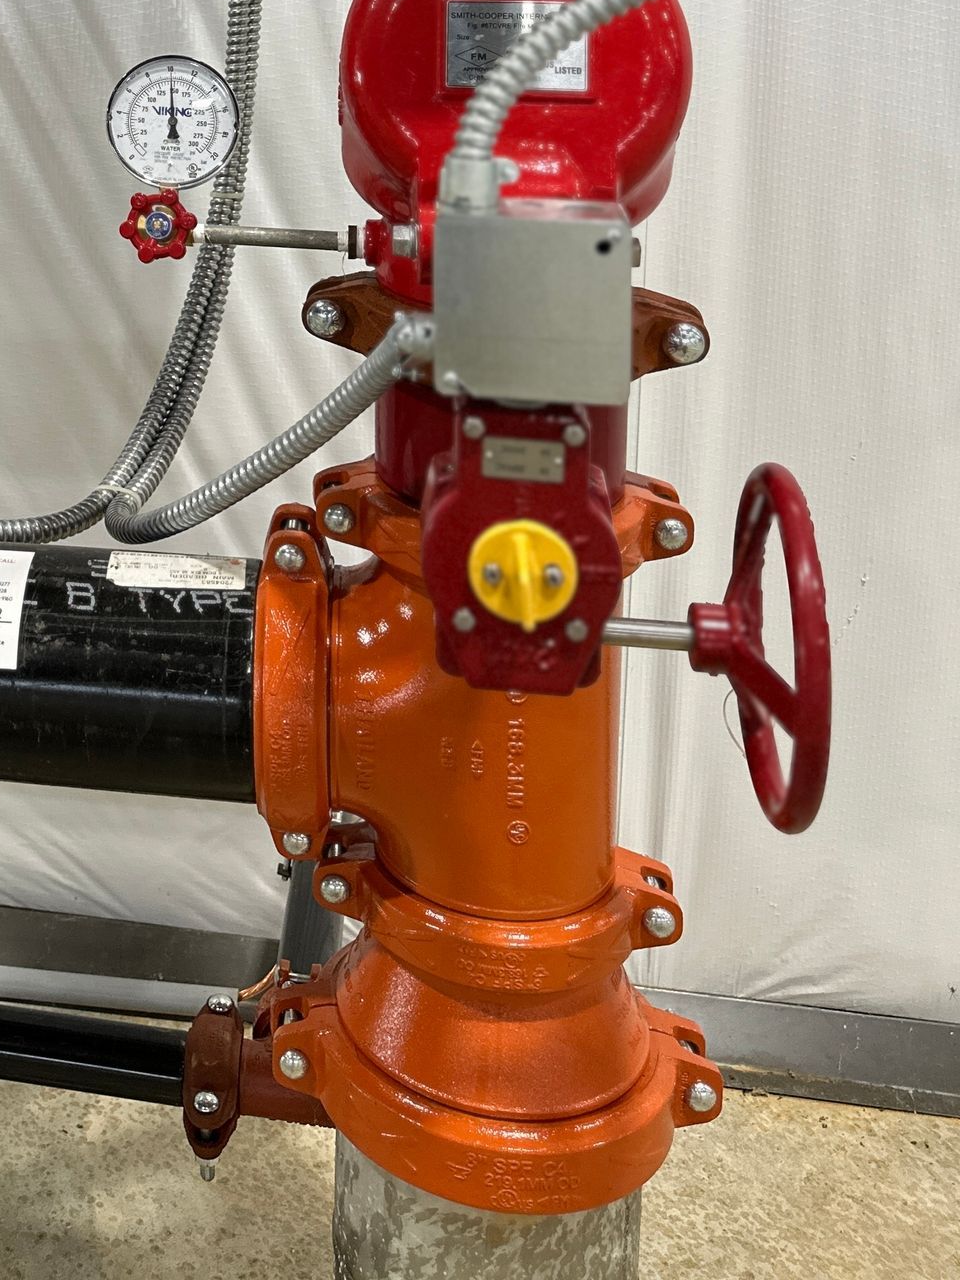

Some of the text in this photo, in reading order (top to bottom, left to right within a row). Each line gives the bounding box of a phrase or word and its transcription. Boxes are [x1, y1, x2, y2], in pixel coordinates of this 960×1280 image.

[471, 52, 487, 60] FM
[152, 106, 192, 117] VIKING
[210, 153, 219, 161] 20
[66, 582, 254, 614] B TYPE
[493, 1157, 533, 1173] SPF
[558, 1176, 581, 1190] OD
